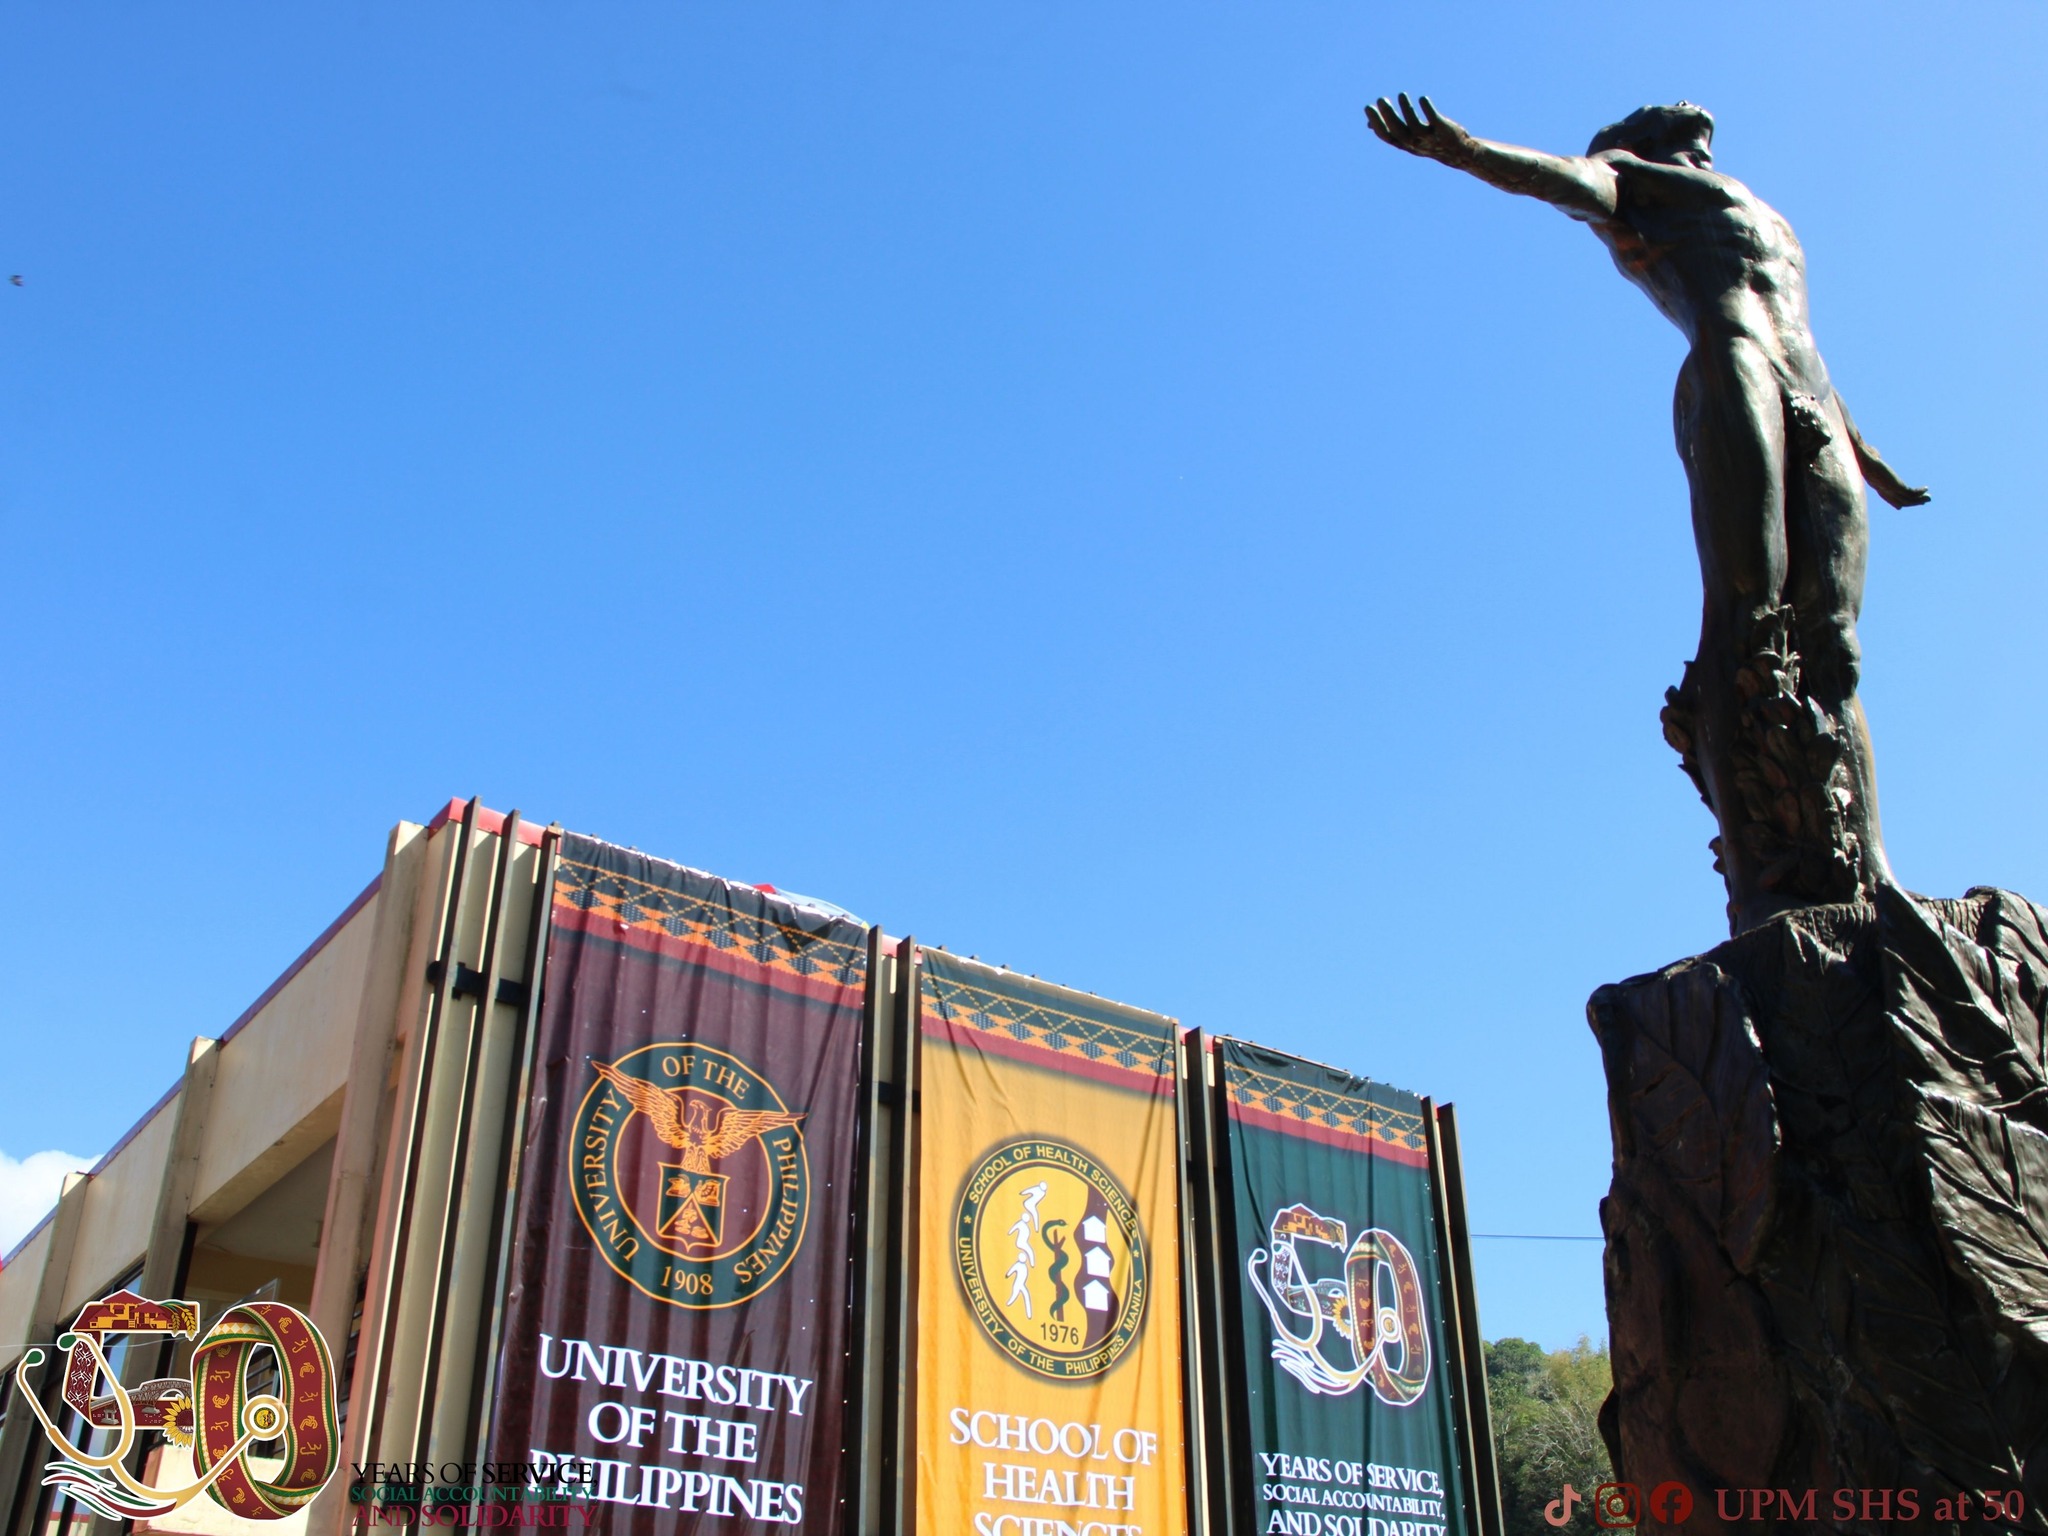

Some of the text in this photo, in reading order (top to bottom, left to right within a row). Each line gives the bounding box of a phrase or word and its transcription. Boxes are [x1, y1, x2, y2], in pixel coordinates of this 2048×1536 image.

[662, 1056, 749, 1099] OF THE
[583, 1089, 640, 1262] UNIVERSITY
[968, 1145, 1138, 1239] SCHOOL OF HEALTH SCIENCES
[733, 1136, 799, 1284] PHILIPPINES
[661, 1266, 713, 1295] 1908
[959, 1237, 1004, 1336] UNIVERSITY
[1007, 1338, 1027, 1356] OF
[1030, 1352, 1055, 1372] THE
[1123, 1279, 1142, 1332] MANILA
[1040, 1322, 1079, 1345] 1976
[539, 1333, 812, 1416] UNIVERSITY
[588, 1402, 758, 1463] OF THE
[949, 1407, 1157, 1466] SCHOOL OF
[528, 1449, 803, 1525] PHILIPPINES
[982, 1462, 1136, 1511] HEALTH
[1259, 1453, 1445, 1499] YEARS OF SERVICE,
[1263, 1484, 1446, 1521] SOCIAL ACCOUNTABILITY,
[1266, 1509, 1321, 1536] AND
